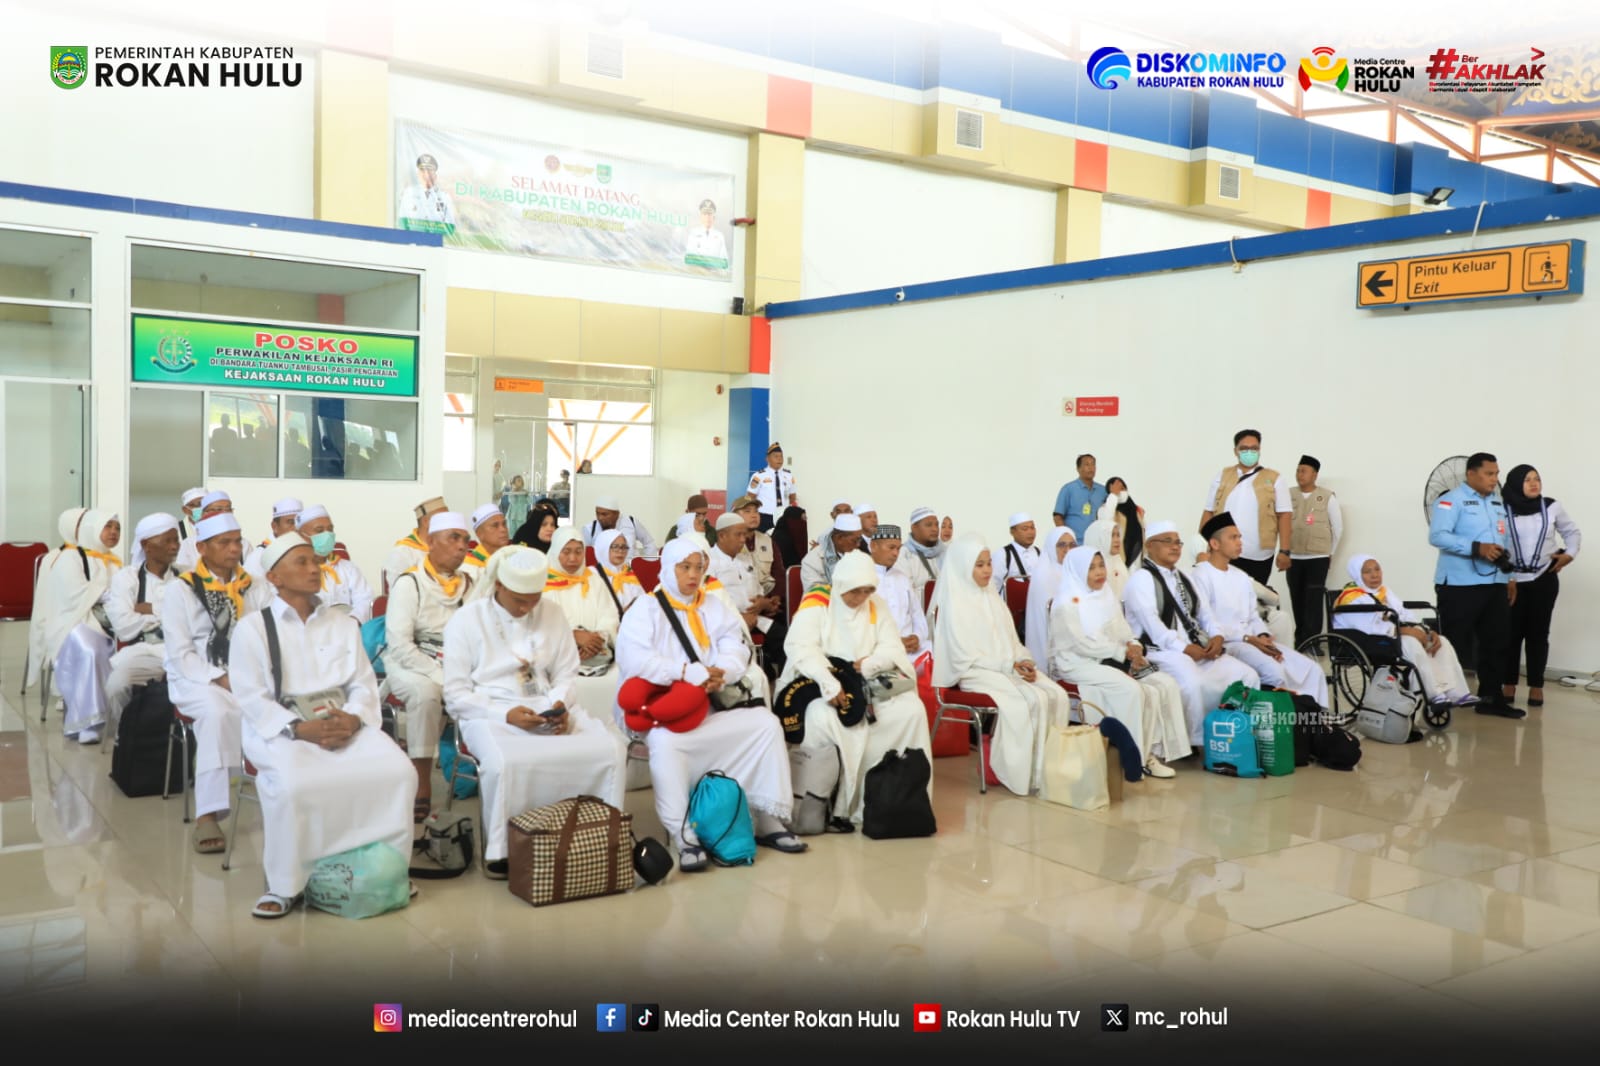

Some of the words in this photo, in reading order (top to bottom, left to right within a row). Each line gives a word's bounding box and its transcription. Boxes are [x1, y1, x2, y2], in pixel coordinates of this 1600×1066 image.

[511, 176, 578, 197] SELAMAT
[584, 186, 640, 207] DATANG
[455, 182, 473, 196] DI
[480, 186, 580, 211] KABUPATEN
[587, 201, 642, 220] ROKAN
[647, 210, 689, 227] HULU
[1414, 264, 1448, 277] Pintu
[1452, 259, 1497, 273] Keluar
[1413, 282, 1440, 295] Exit
[255, 332, 359, 354] POSKO
[216, 347, 300, 361] PERWAKILAN
[304, 353, 377, 366] KEJAKSAAN
[381, 359, 393, 367] RI
[210, 358, 218, 366] DI
[220, 358, 257, 368] BANDARA
[259, 361, 289, 370] TUANKU
[331, 366, 352, 374] PASIR
[354, 367, 398, 377] PENGARAIAN
[224, 369, 302, 383] KEJAKSAAN
[306, 374, 349, 386] ROKAN
[352, 377, 385, 388] HULU
[1209, 738, 1232, 753] BSI
